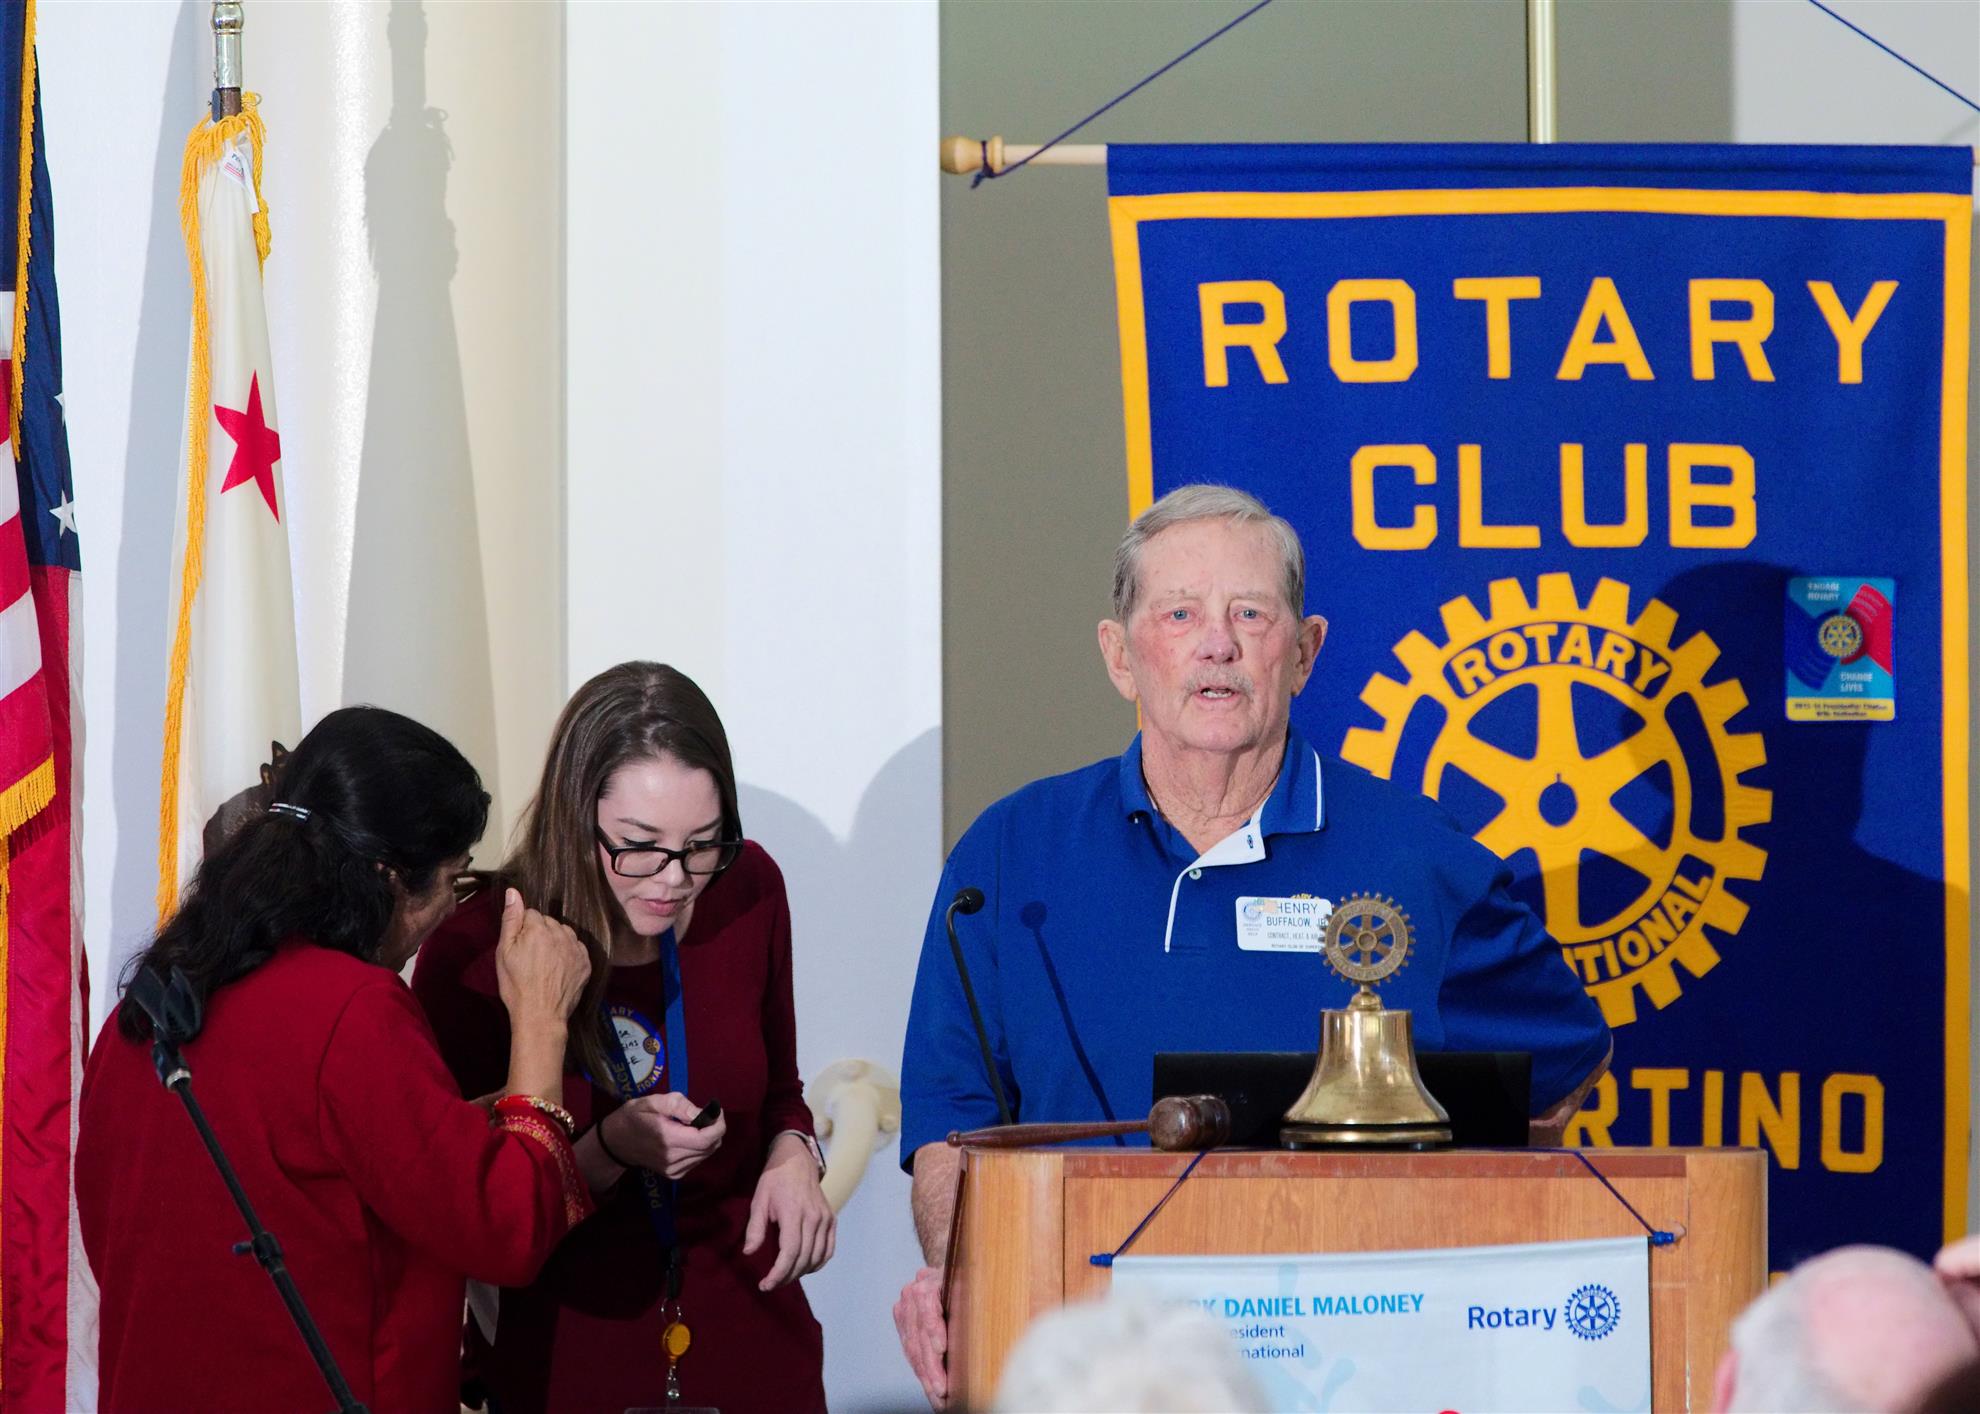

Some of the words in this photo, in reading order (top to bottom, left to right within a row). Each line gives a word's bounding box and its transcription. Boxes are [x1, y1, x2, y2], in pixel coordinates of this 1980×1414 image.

[1198, 276, 1899, 388] ROTARY
[1350, 442, 1758, 550] CLUB
[1450, 623, 1671, 696] ROTARY
[1277, 902, 1318, 914] HENRY
[1562, 873, 1714, 984] TIONAL
[1562, 1067, 1885, 1174] RTINO
[1224, 1297, 1307, 1318] DANIEL
[1312, 1293, 1425, 1316] MALONEY
[1467, 1305, 1557, 1331] Rotary
[1230, 1323, 1286, 1339] esident
[1240, 1343, 1305, 1359] national
